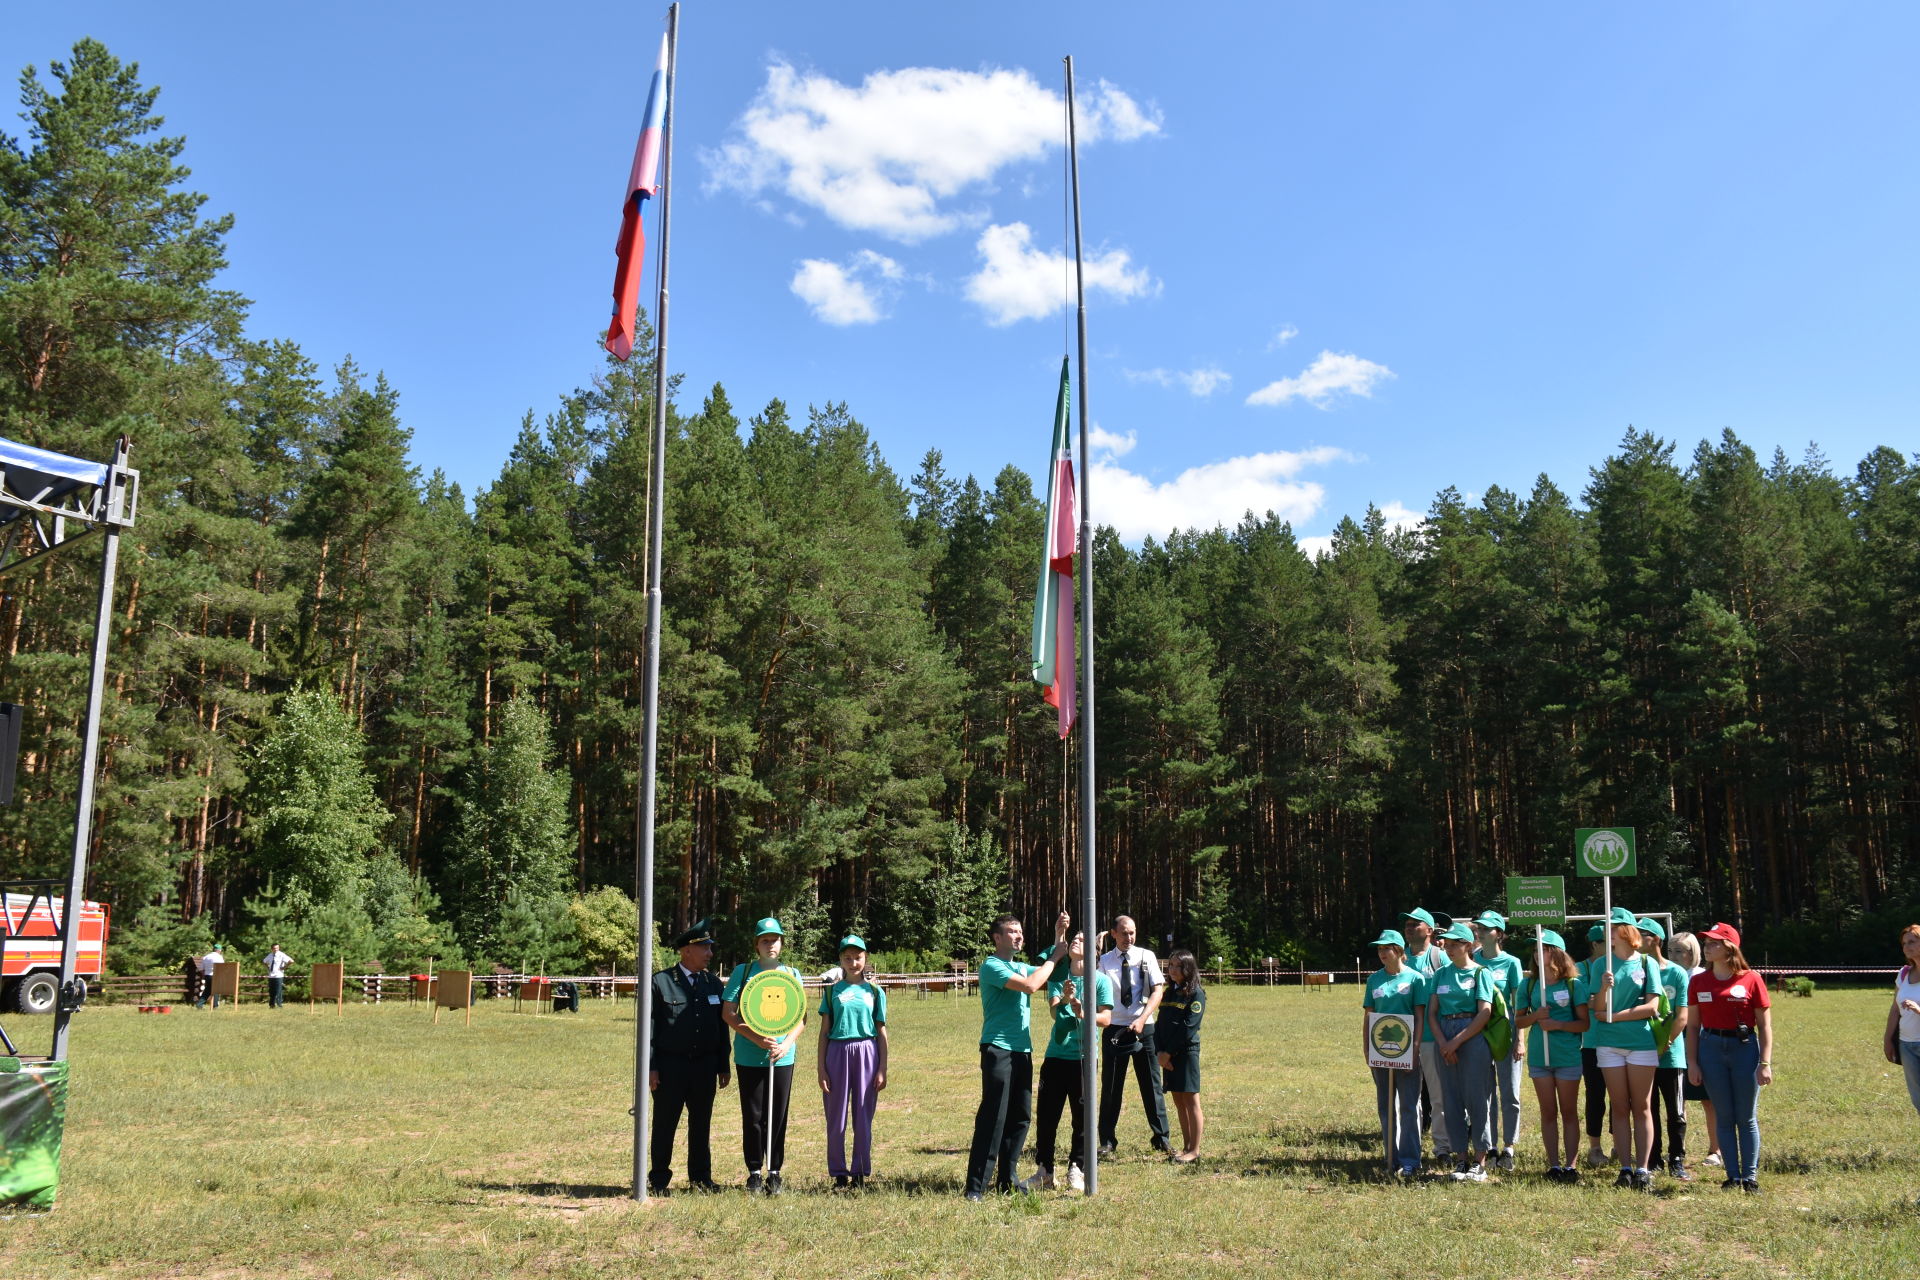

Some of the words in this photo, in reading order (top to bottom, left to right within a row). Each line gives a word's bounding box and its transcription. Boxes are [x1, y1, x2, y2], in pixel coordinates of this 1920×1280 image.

[1515, 895, 1557, 905] «Юный
[1510, 910, 1563, 918] лесовод»
[1370, 1060, 1411, 1069] ЧЕРЕМШАН
